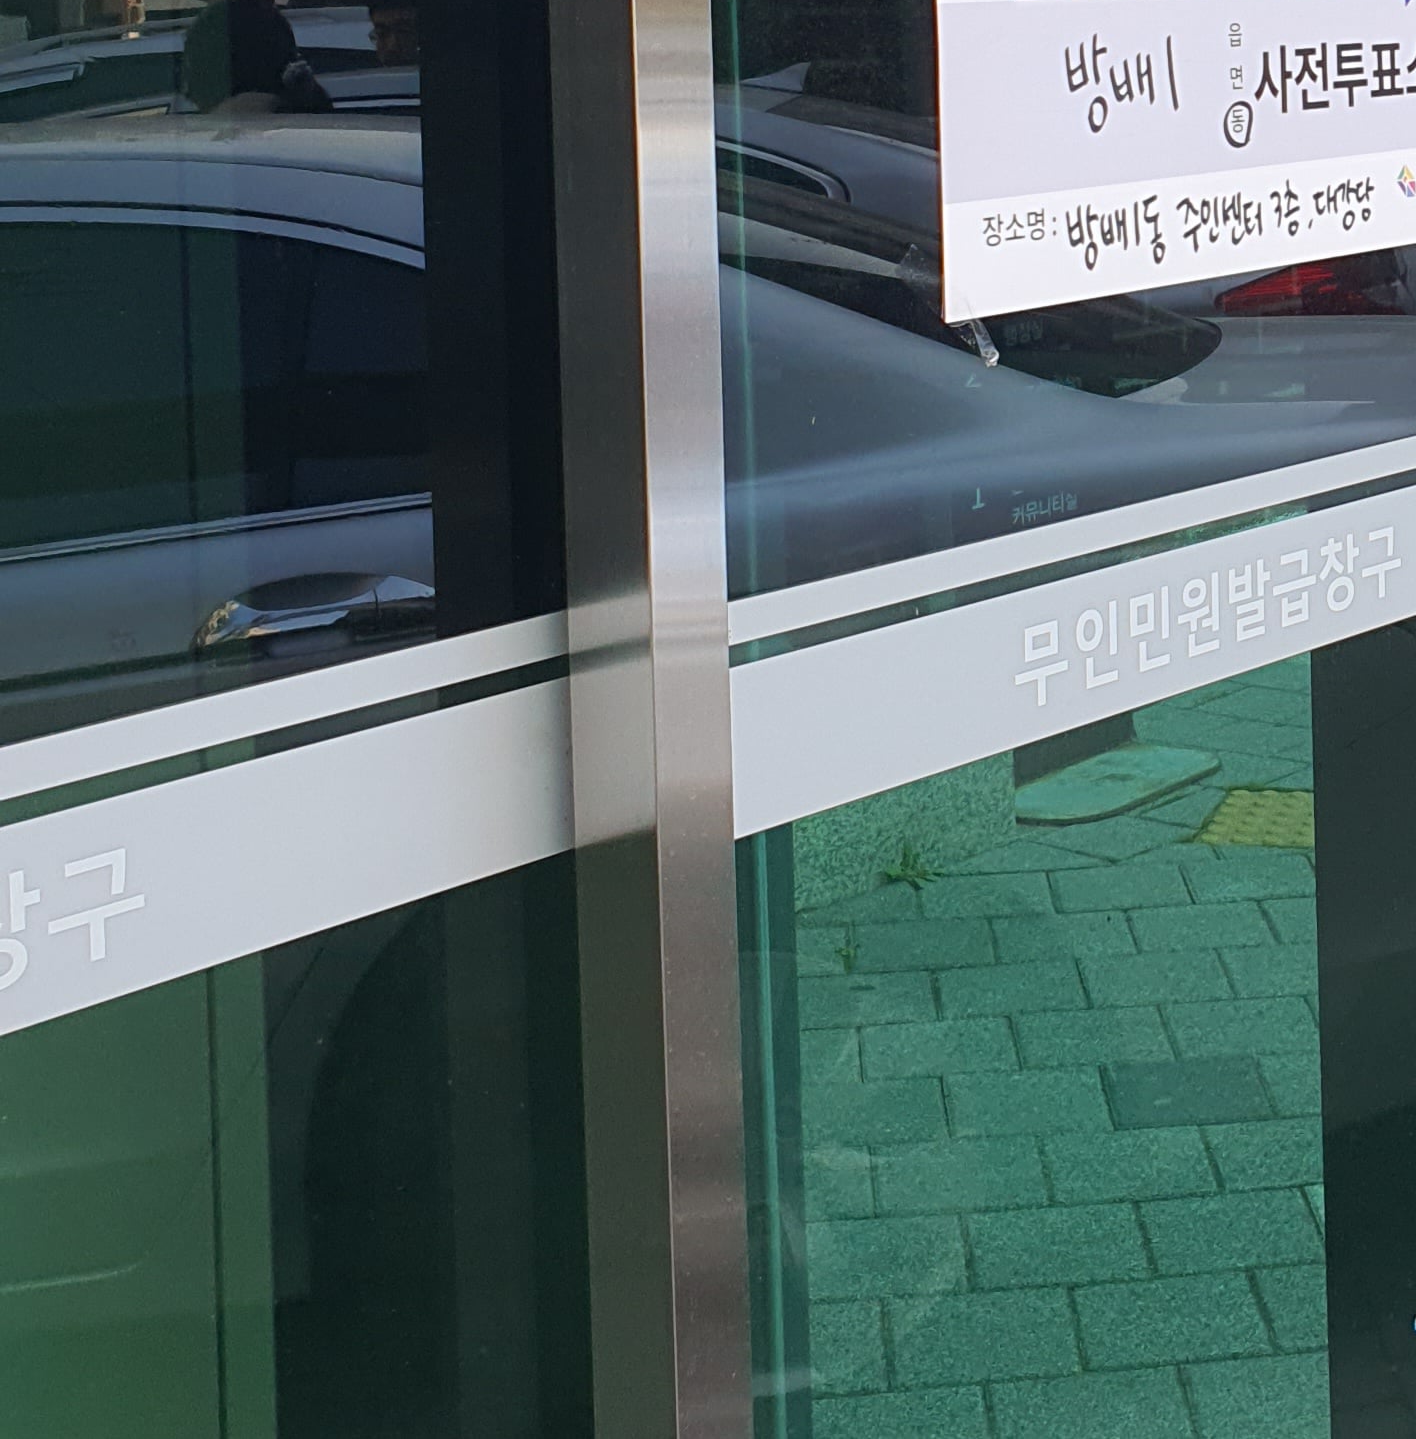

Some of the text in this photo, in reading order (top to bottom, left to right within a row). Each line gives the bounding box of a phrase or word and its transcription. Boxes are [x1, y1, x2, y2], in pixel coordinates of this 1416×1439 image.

[1228, 22, 1242, 48] 읍
[1229, 65, 1244, 91] 면
[1014, 526, 1402, 707] 무인민원발급창구
